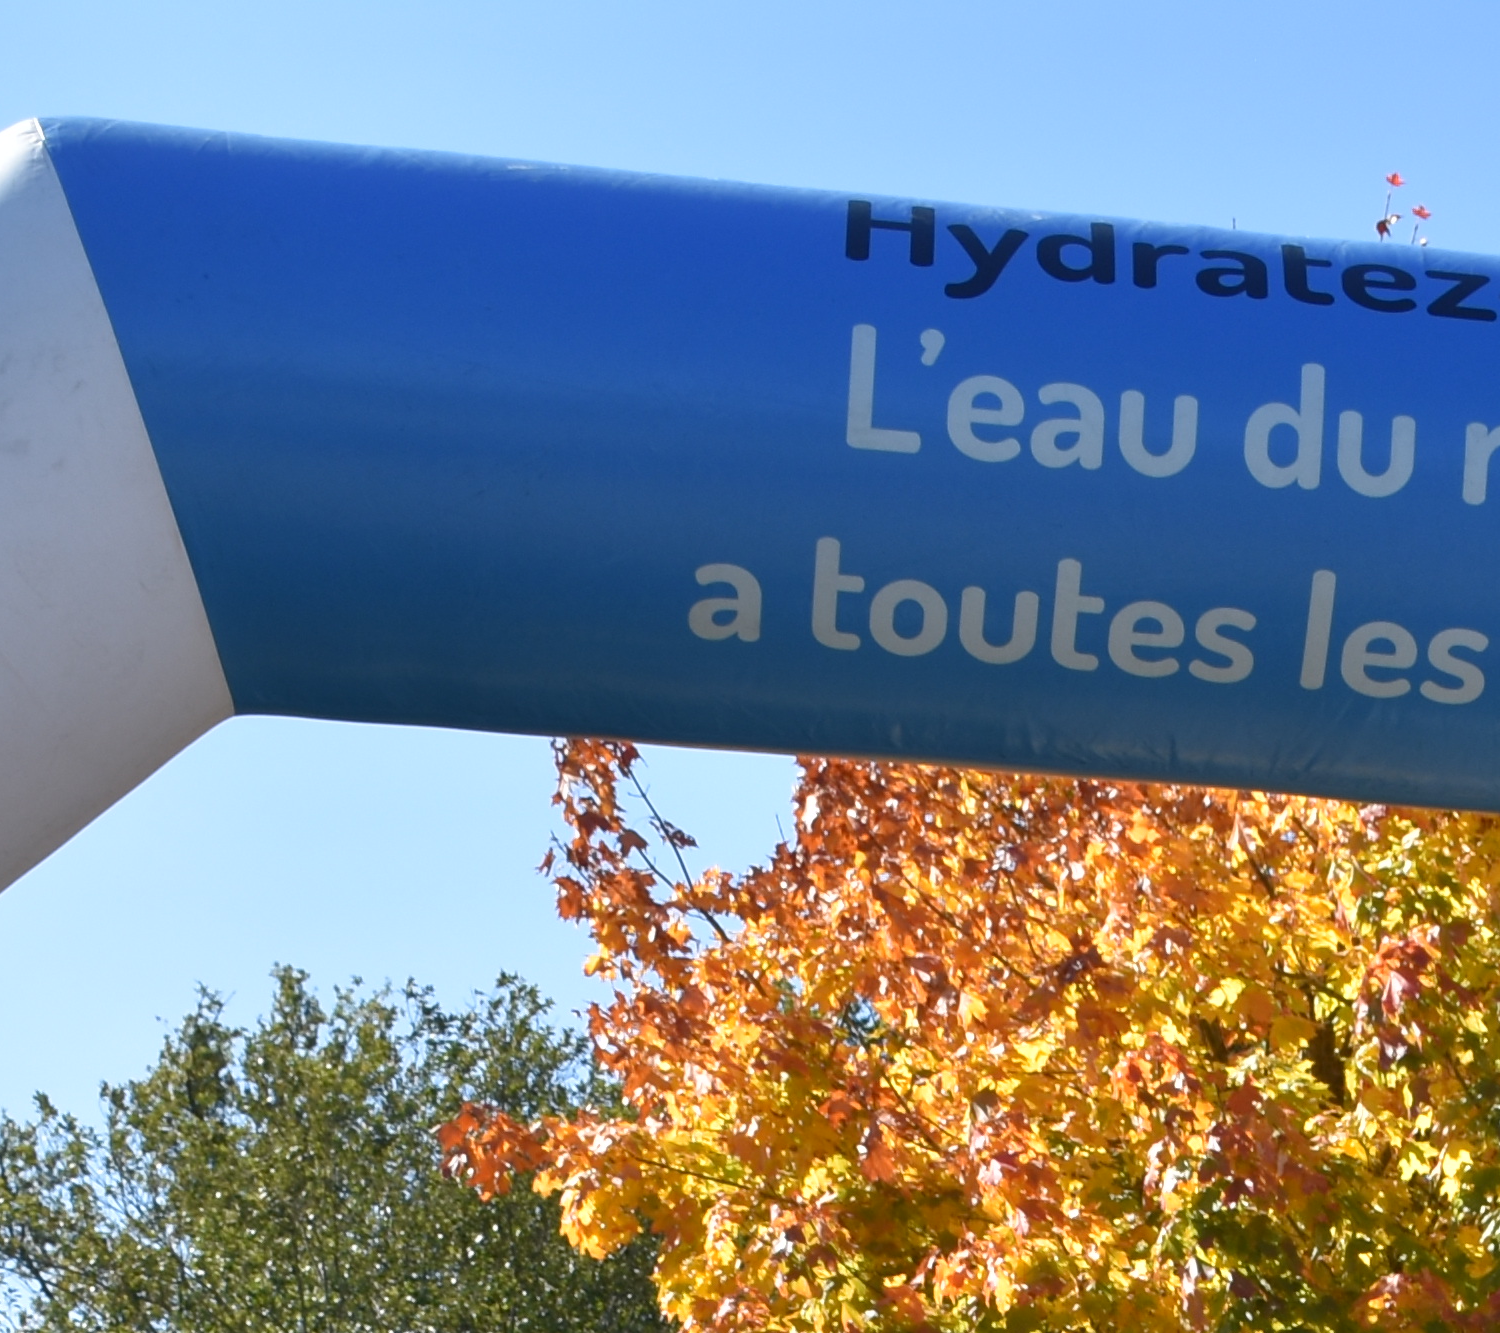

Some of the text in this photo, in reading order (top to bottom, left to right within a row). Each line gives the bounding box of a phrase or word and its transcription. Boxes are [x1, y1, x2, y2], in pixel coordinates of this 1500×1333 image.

[844, 322, 1199, 479] L'eau
[1242, 361, 1417, 499] du
[686, 560, 764, 644] a
[810, 535, 1258, 684] toutes
[1299, 569, 1490, 707] les
